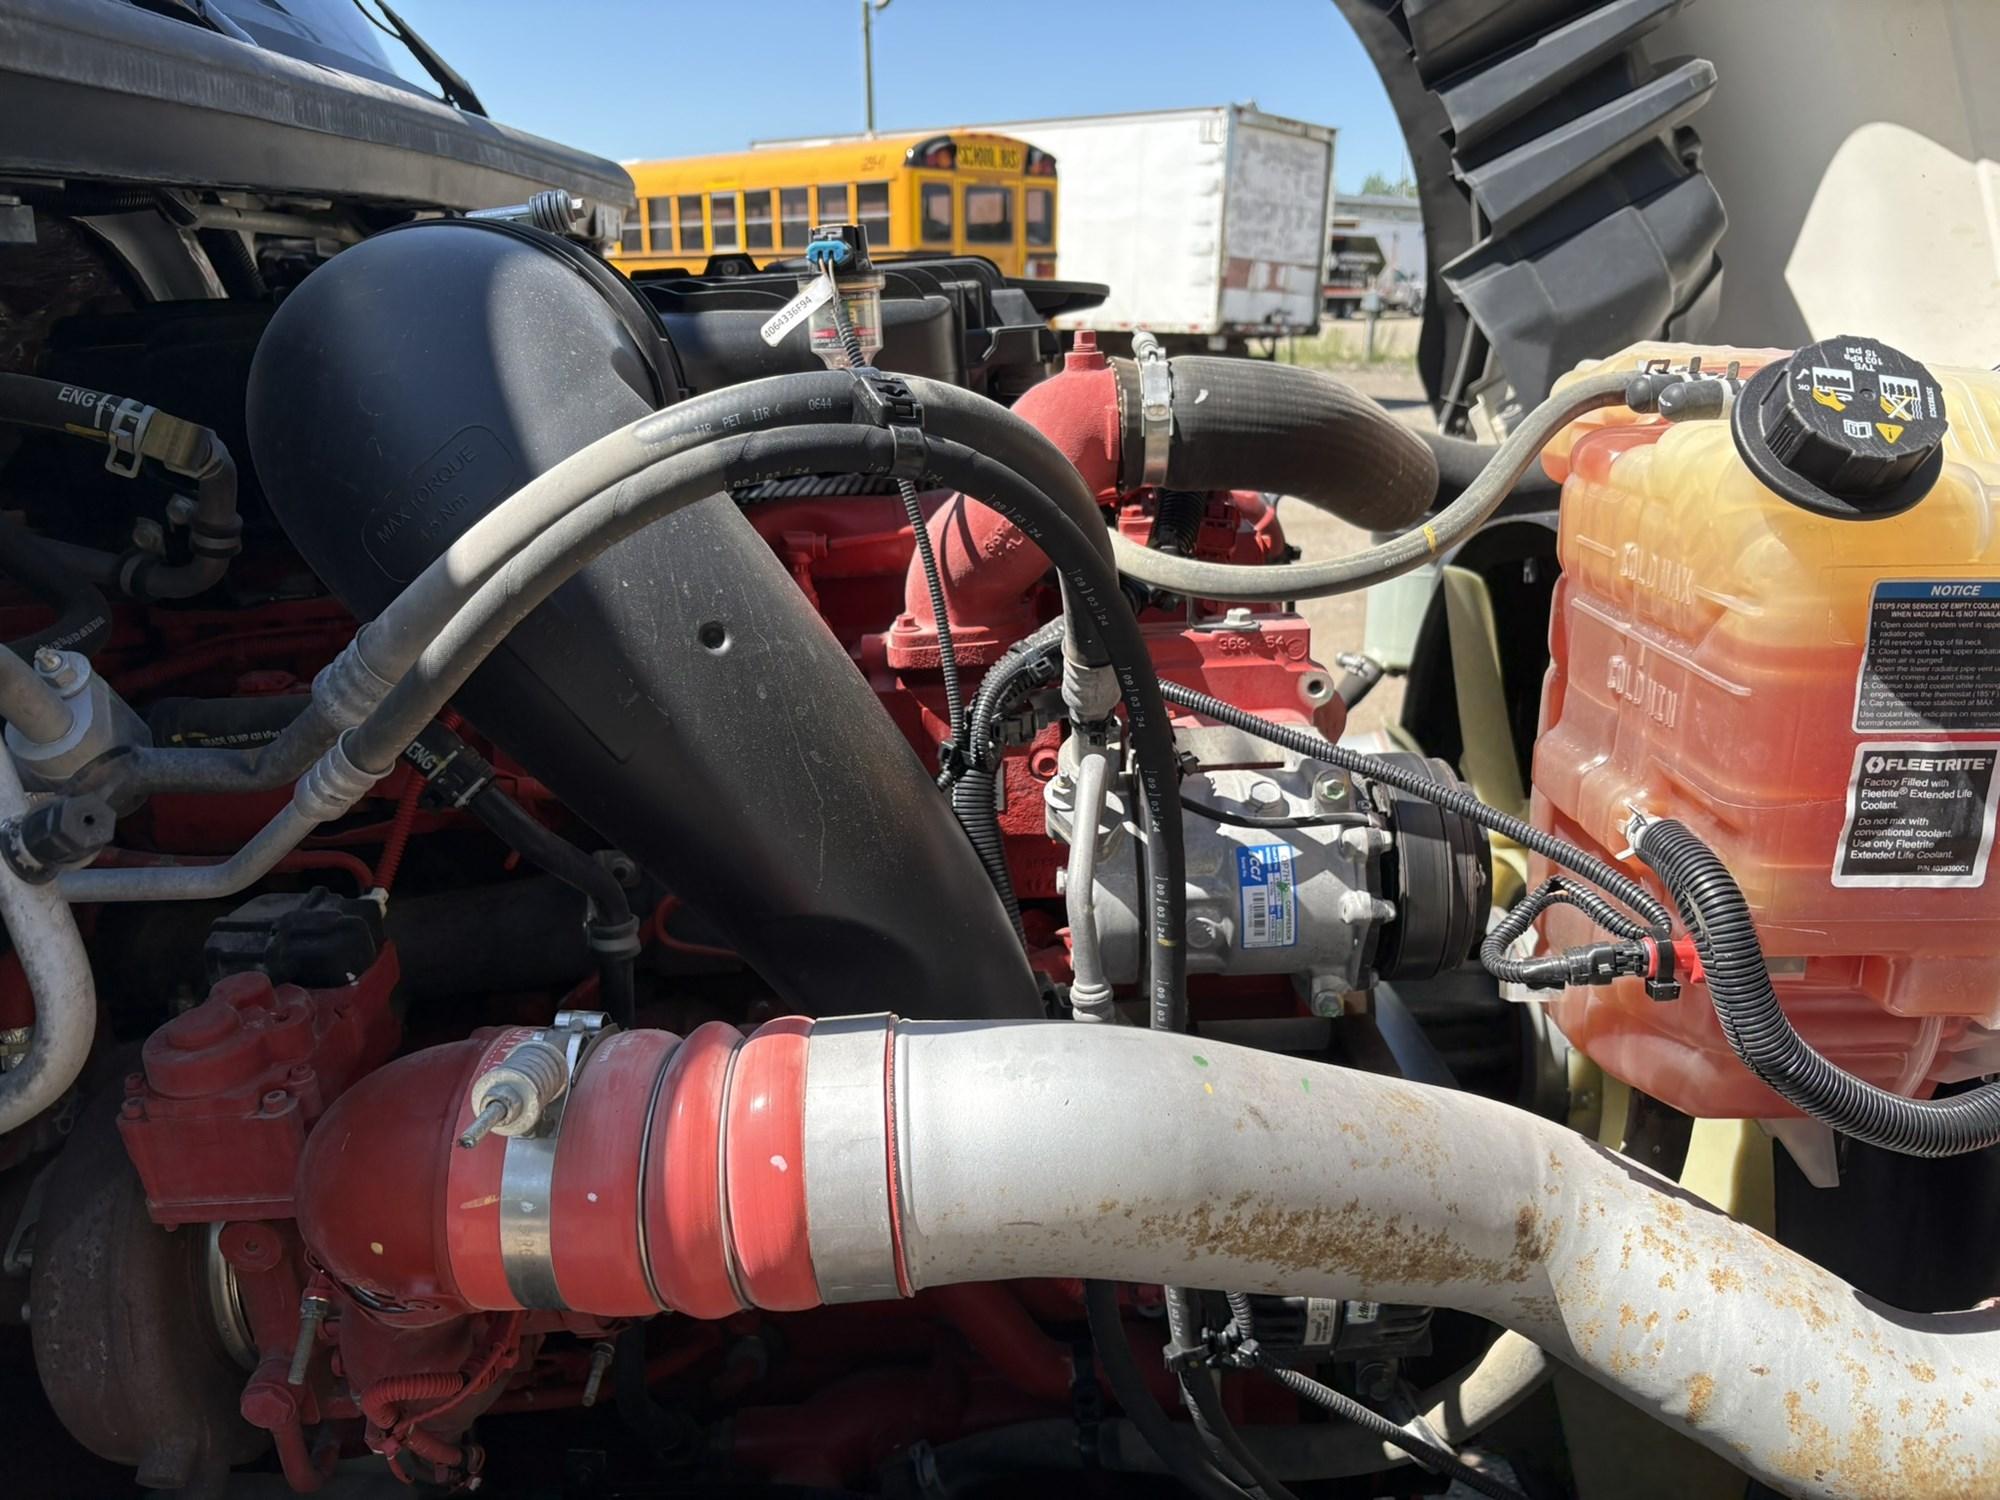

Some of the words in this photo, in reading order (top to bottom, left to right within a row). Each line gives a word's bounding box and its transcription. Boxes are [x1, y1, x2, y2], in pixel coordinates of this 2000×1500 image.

[999, 149, 1019, 169] BUS
[1846, 346, 1862, 355] psi
[1865, 349, 1878, 358] 15
[1863, 356, 1884, 366] 103
[1854, 363, 1876, 372] TVS
[1798, 383, 1810, 391] OK
[57, 386, 97, 408] ENG
[722, 413, 742, 429] PET
[807, 398, 833, 411] 0644
[1930, 584, 1982, 597] NOTICE
[1874, 602, 1896, 610] STEPS
[1896, 602, 1911, 610] FOR
[1911, 602, 1940, 610] SERVICE
[1940, 602, 1950, 610] OF
[1950, 602, 1972, 610] EMPTY
[1891, 610, 1911, 618] WHEN
[1912, 610, 1940, 618] VACUUM
[1940, 610, 1955, 618] FILL
[1955, 610, 1962, 618] IS
[1963, 610, 1978, 618] NOT
[1880, 621, 1901, 630] Open
[1902, 620, 1930, 629] coolant
[1931, 621, 1957, 630] system
[1958, 621, 1975, 629] vent
[1880, 630, 1907, 638] radiator
[1880, 639, 1890, 647] Fill
[1891, 639, 1923, 647] reservoir
[1924, 639, 1933, 647] to
[1933, 639, 1946, 647] top
[1879, 647, 1900, 656] Close
[1900, 648, 1913, 656] the
[1914, 648, 1930, 656] vent
[1940, 648, 1951, 656] the
[1952, 649, 1973, 657] upper
[1877, 657, 1897, 665] when
[1874, 665, 1896, 674] Open
[1896, 665, 1909, 673] the
[1910, 664, 1931, 672] lower
[1931, 665, 1959, 673] radiator
[1959, 666, 1976, 674] pipe
[1977, 665, 1994, 673] vent
[1872, 673, 1899, 681] coolant
[1871, 681, 1905, 690] Continue
[1928, 682, 1955, 690] coolant
[1870, 691, 1895, 700] engine
[1895, 691, 1919, 699] opens
[1920, 690, 1933, 698] the
[1934, 690, 1972, 698] thermostat
[1869, 699, 1885, 708] Cap
[1886, 700, 1912, 709] system
[1933, 698, 1967, 706] stabilized
[1976, 698, 1994, 706] MAX
[1859, 710, 1875, 718] Use
[1875, 710, 1904, 718] coolant
[1922, 710, 1957, 718] indicators
[1858, 719, 1885, 728] normal
[405, 741, 437, 770] ENG
[1863, 777, 1899, 788] Factory
[1900, 777, 1929, 787] Filled
[1930, 778, 1950, 788] with
[1909, 788, 1955, 799] Extended
[1956, 789, 1973, 798] Life
[1860, 800, 1898, 810] Coolant.
[1857, 817, 1871, 826] Do
[1873, 817, 1888, 826] not
[1889, 817, 1906, 825] mix
[1908, 816, 1929, 826] with
[1854, 827, 1914, 837] conventional
[1915, 828, 1953, 838] coolant.
[1852, 839, 1871, 848] Use
[1873, 839, 1894, 850] only
[1896, 839, 1935, 849] Fleetrite
[1850, 850, 1895, 859] Extended
[1897, 849, 1915, 859] Life
[1916, 850, 1954, 859] Coolant.
